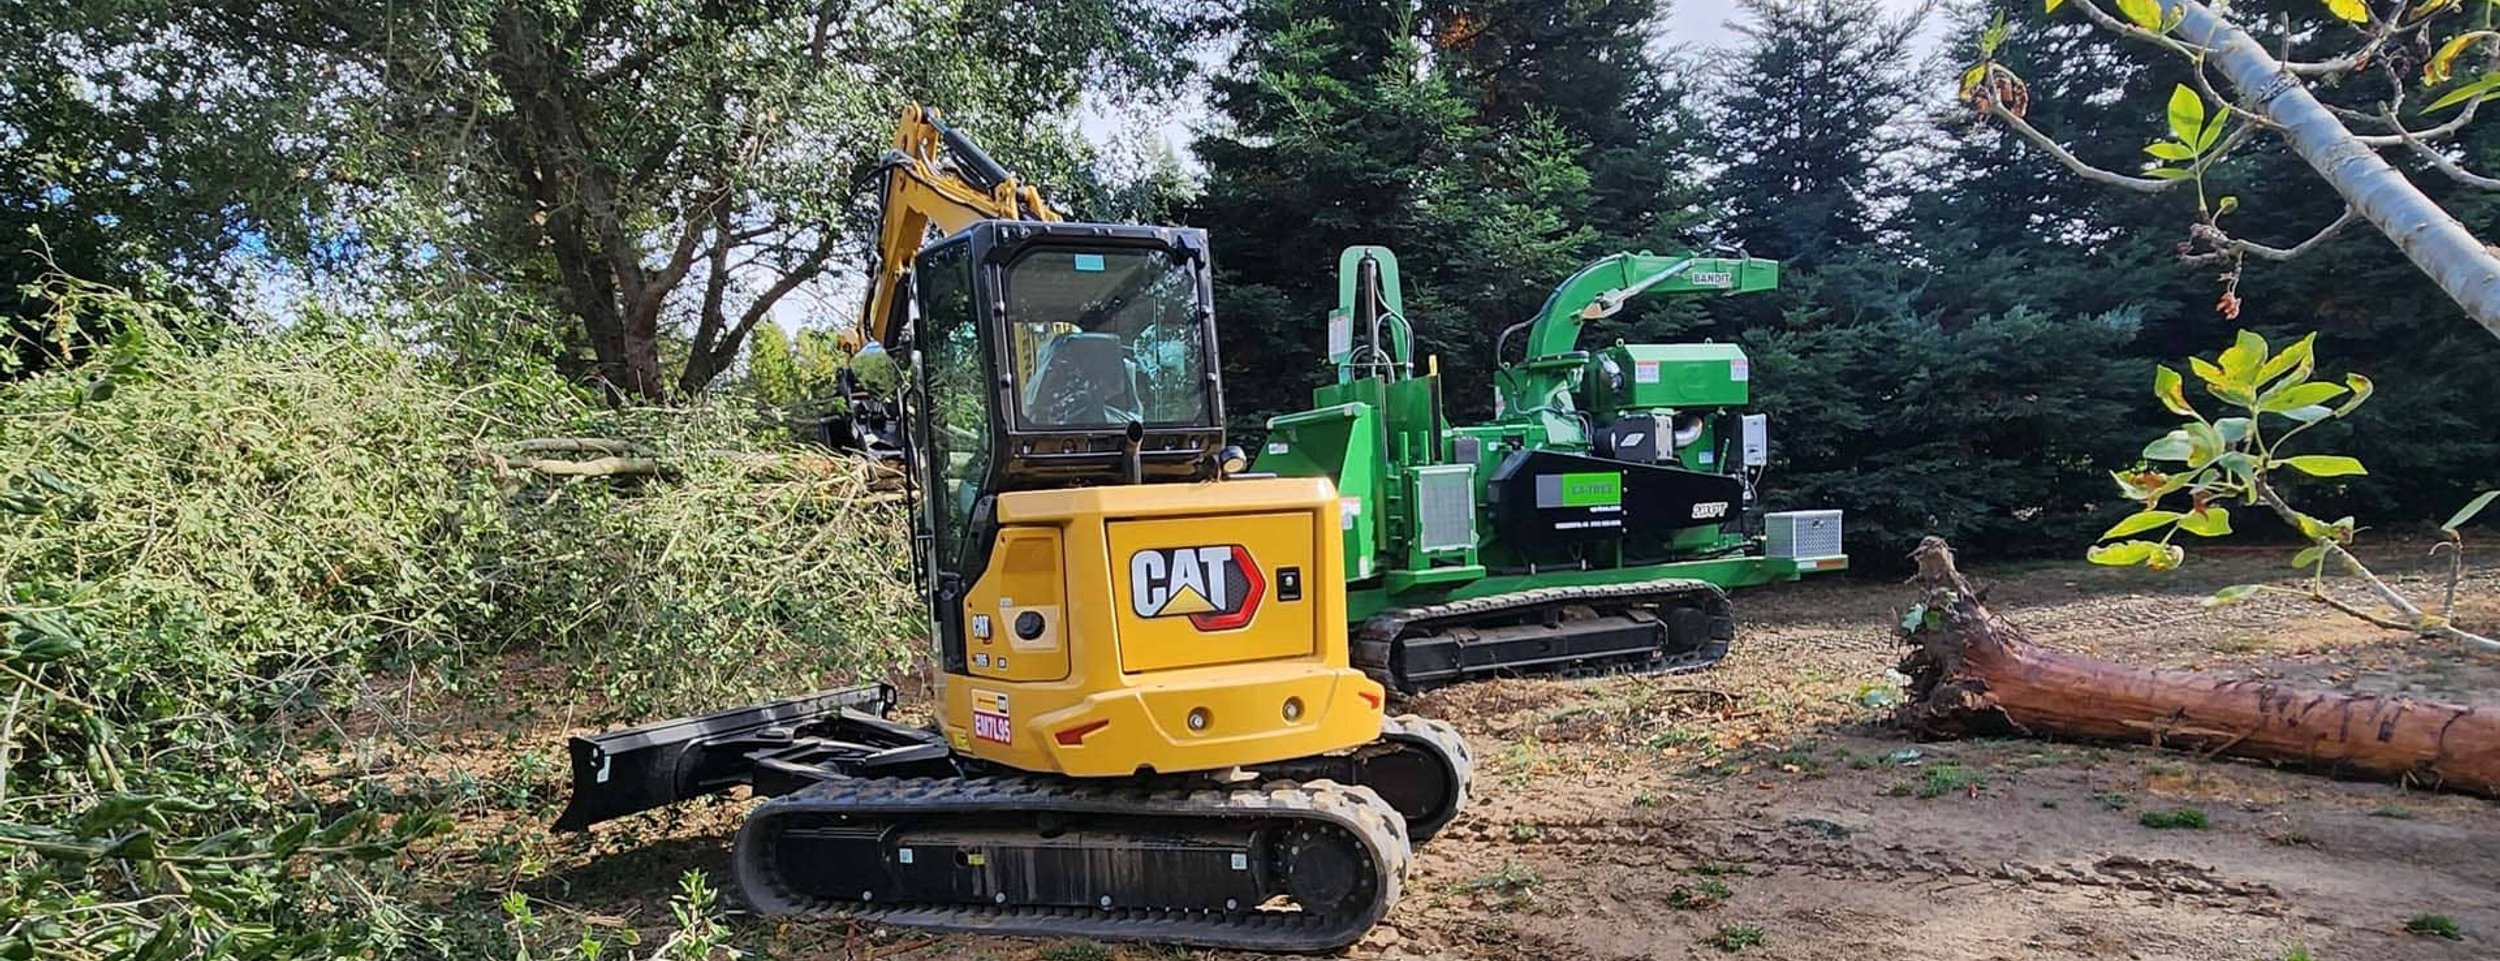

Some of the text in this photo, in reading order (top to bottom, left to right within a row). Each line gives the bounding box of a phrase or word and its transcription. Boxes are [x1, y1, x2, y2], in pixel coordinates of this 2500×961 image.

[1694, 273, 1730, 283] BANDIT
[1131, 546, 1232, 617] CAT
[972, 615, 989, 638] CAT
[975, 714, 1011, 744] EM7L95
